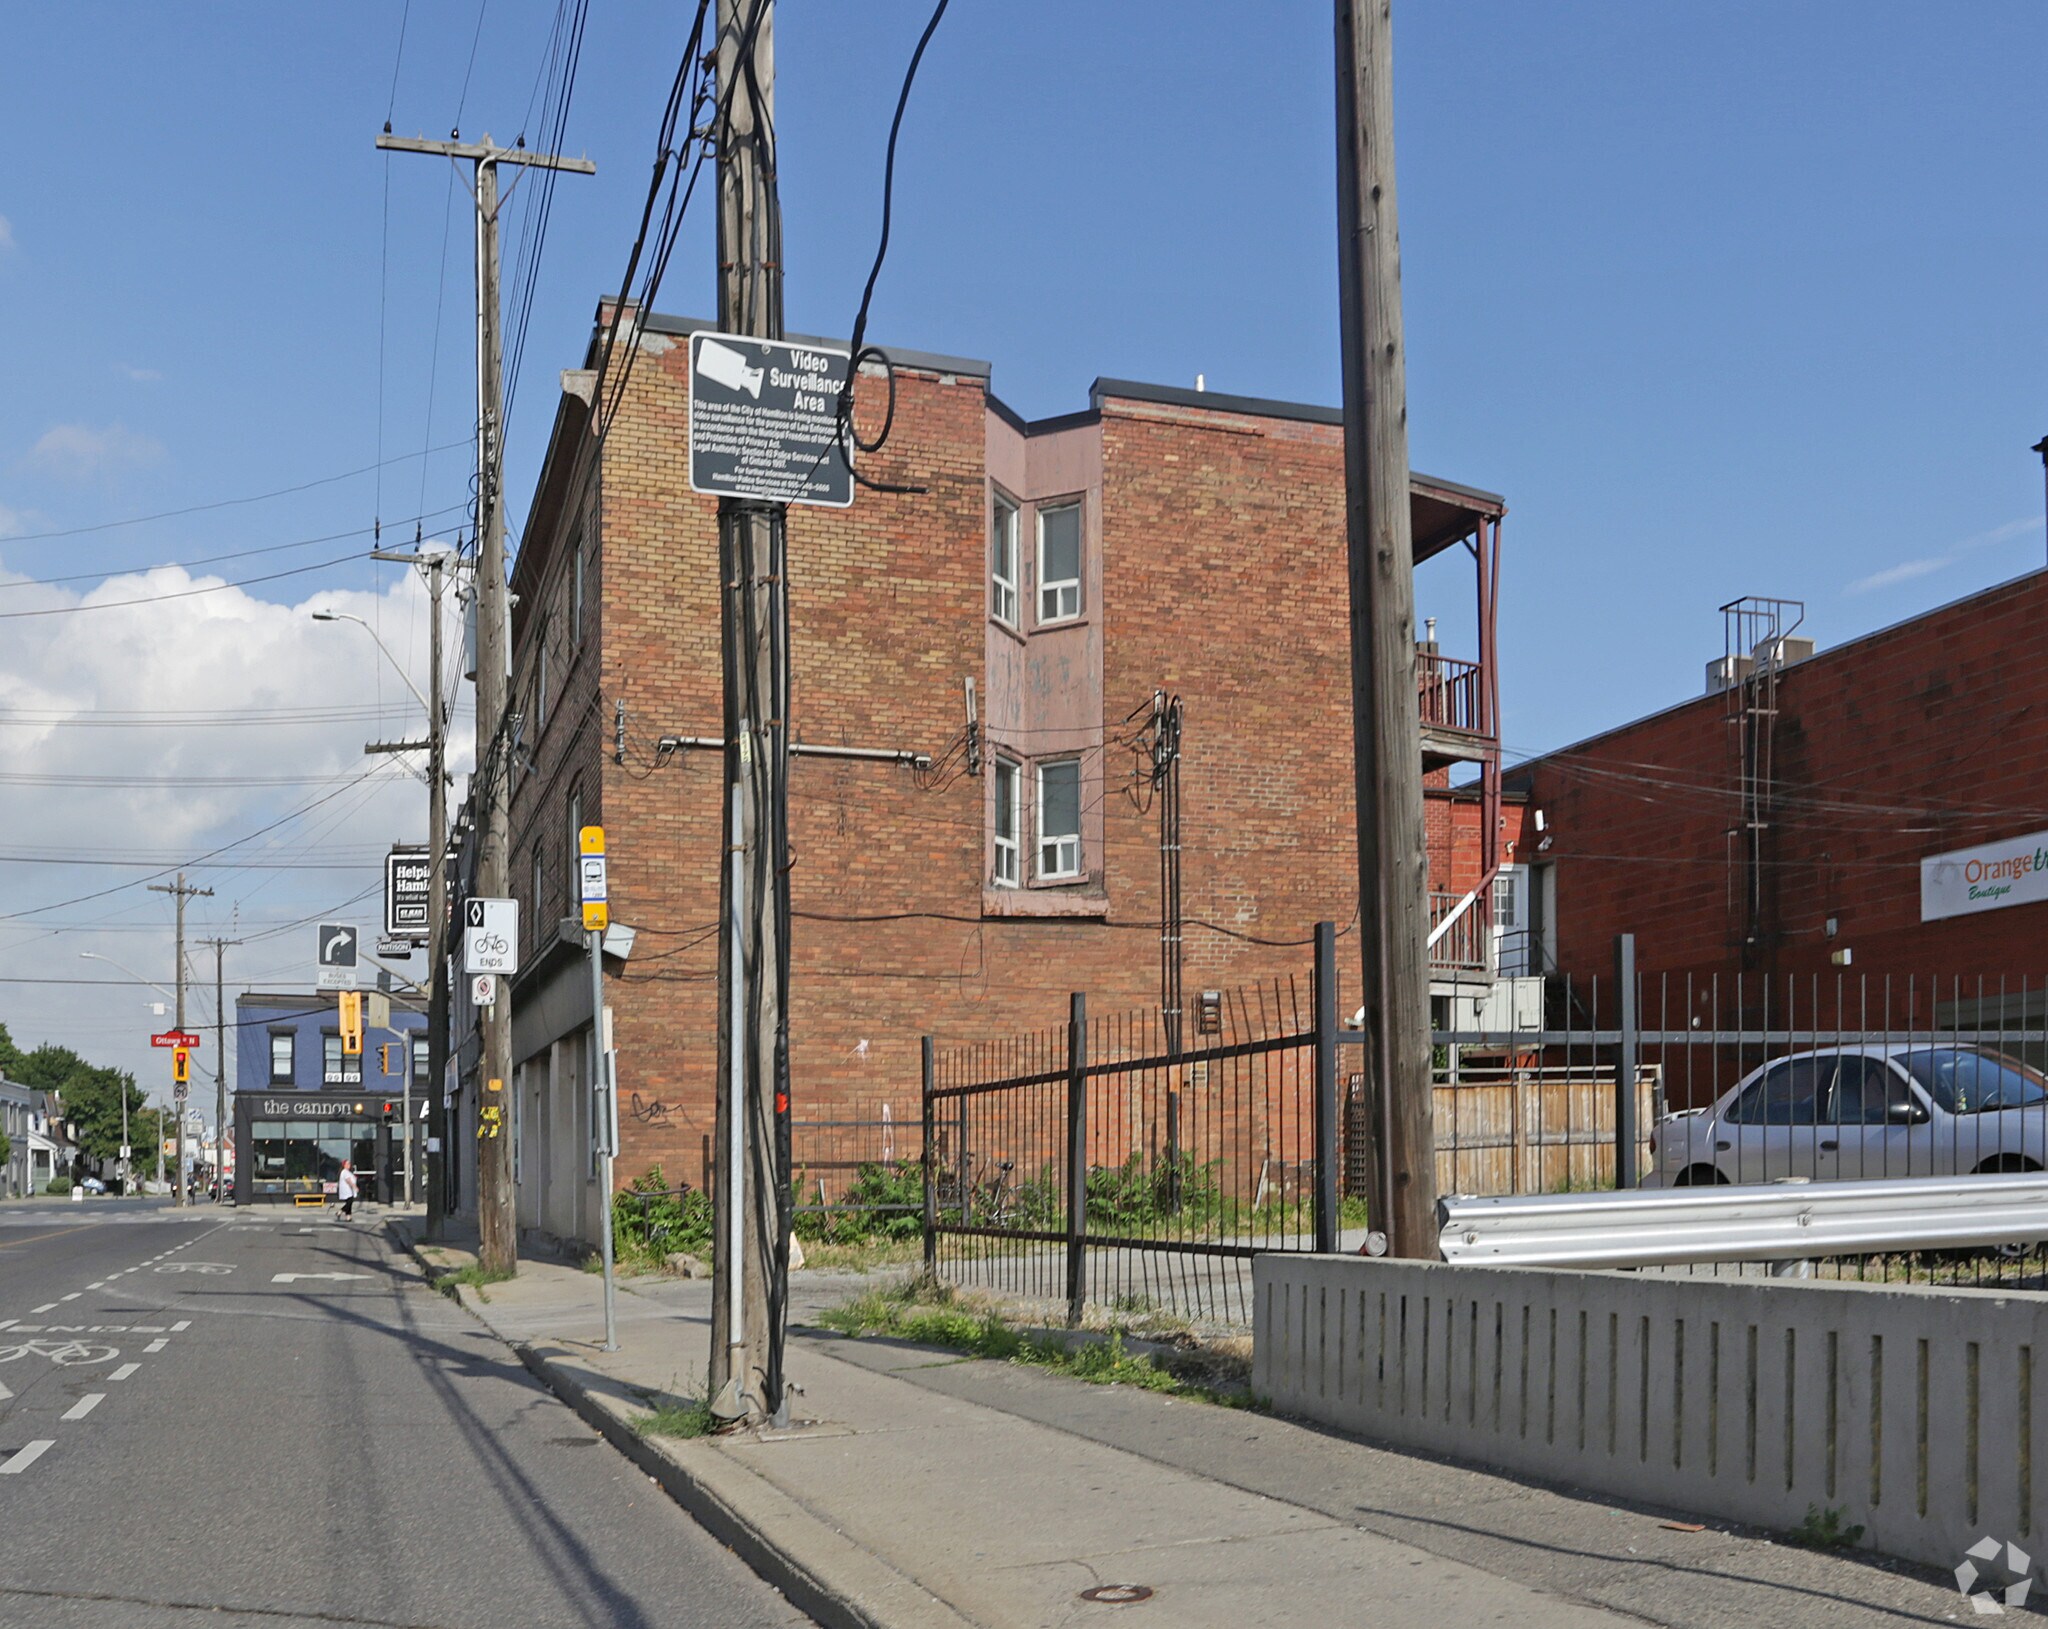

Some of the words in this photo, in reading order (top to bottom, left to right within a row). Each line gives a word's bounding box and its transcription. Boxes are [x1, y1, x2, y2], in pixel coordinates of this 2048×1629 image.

[790, 350, 828, 372] Video
[794, 390, 826, 412] Area
[396, 866, 430, 880] Helpi
[1968, 885, 2011, 900] Boutique
[480, 958, 502, 967] ENDS
[264, 1099, 290, 1114] the
[294, 1102, 352, 1115] cannon
